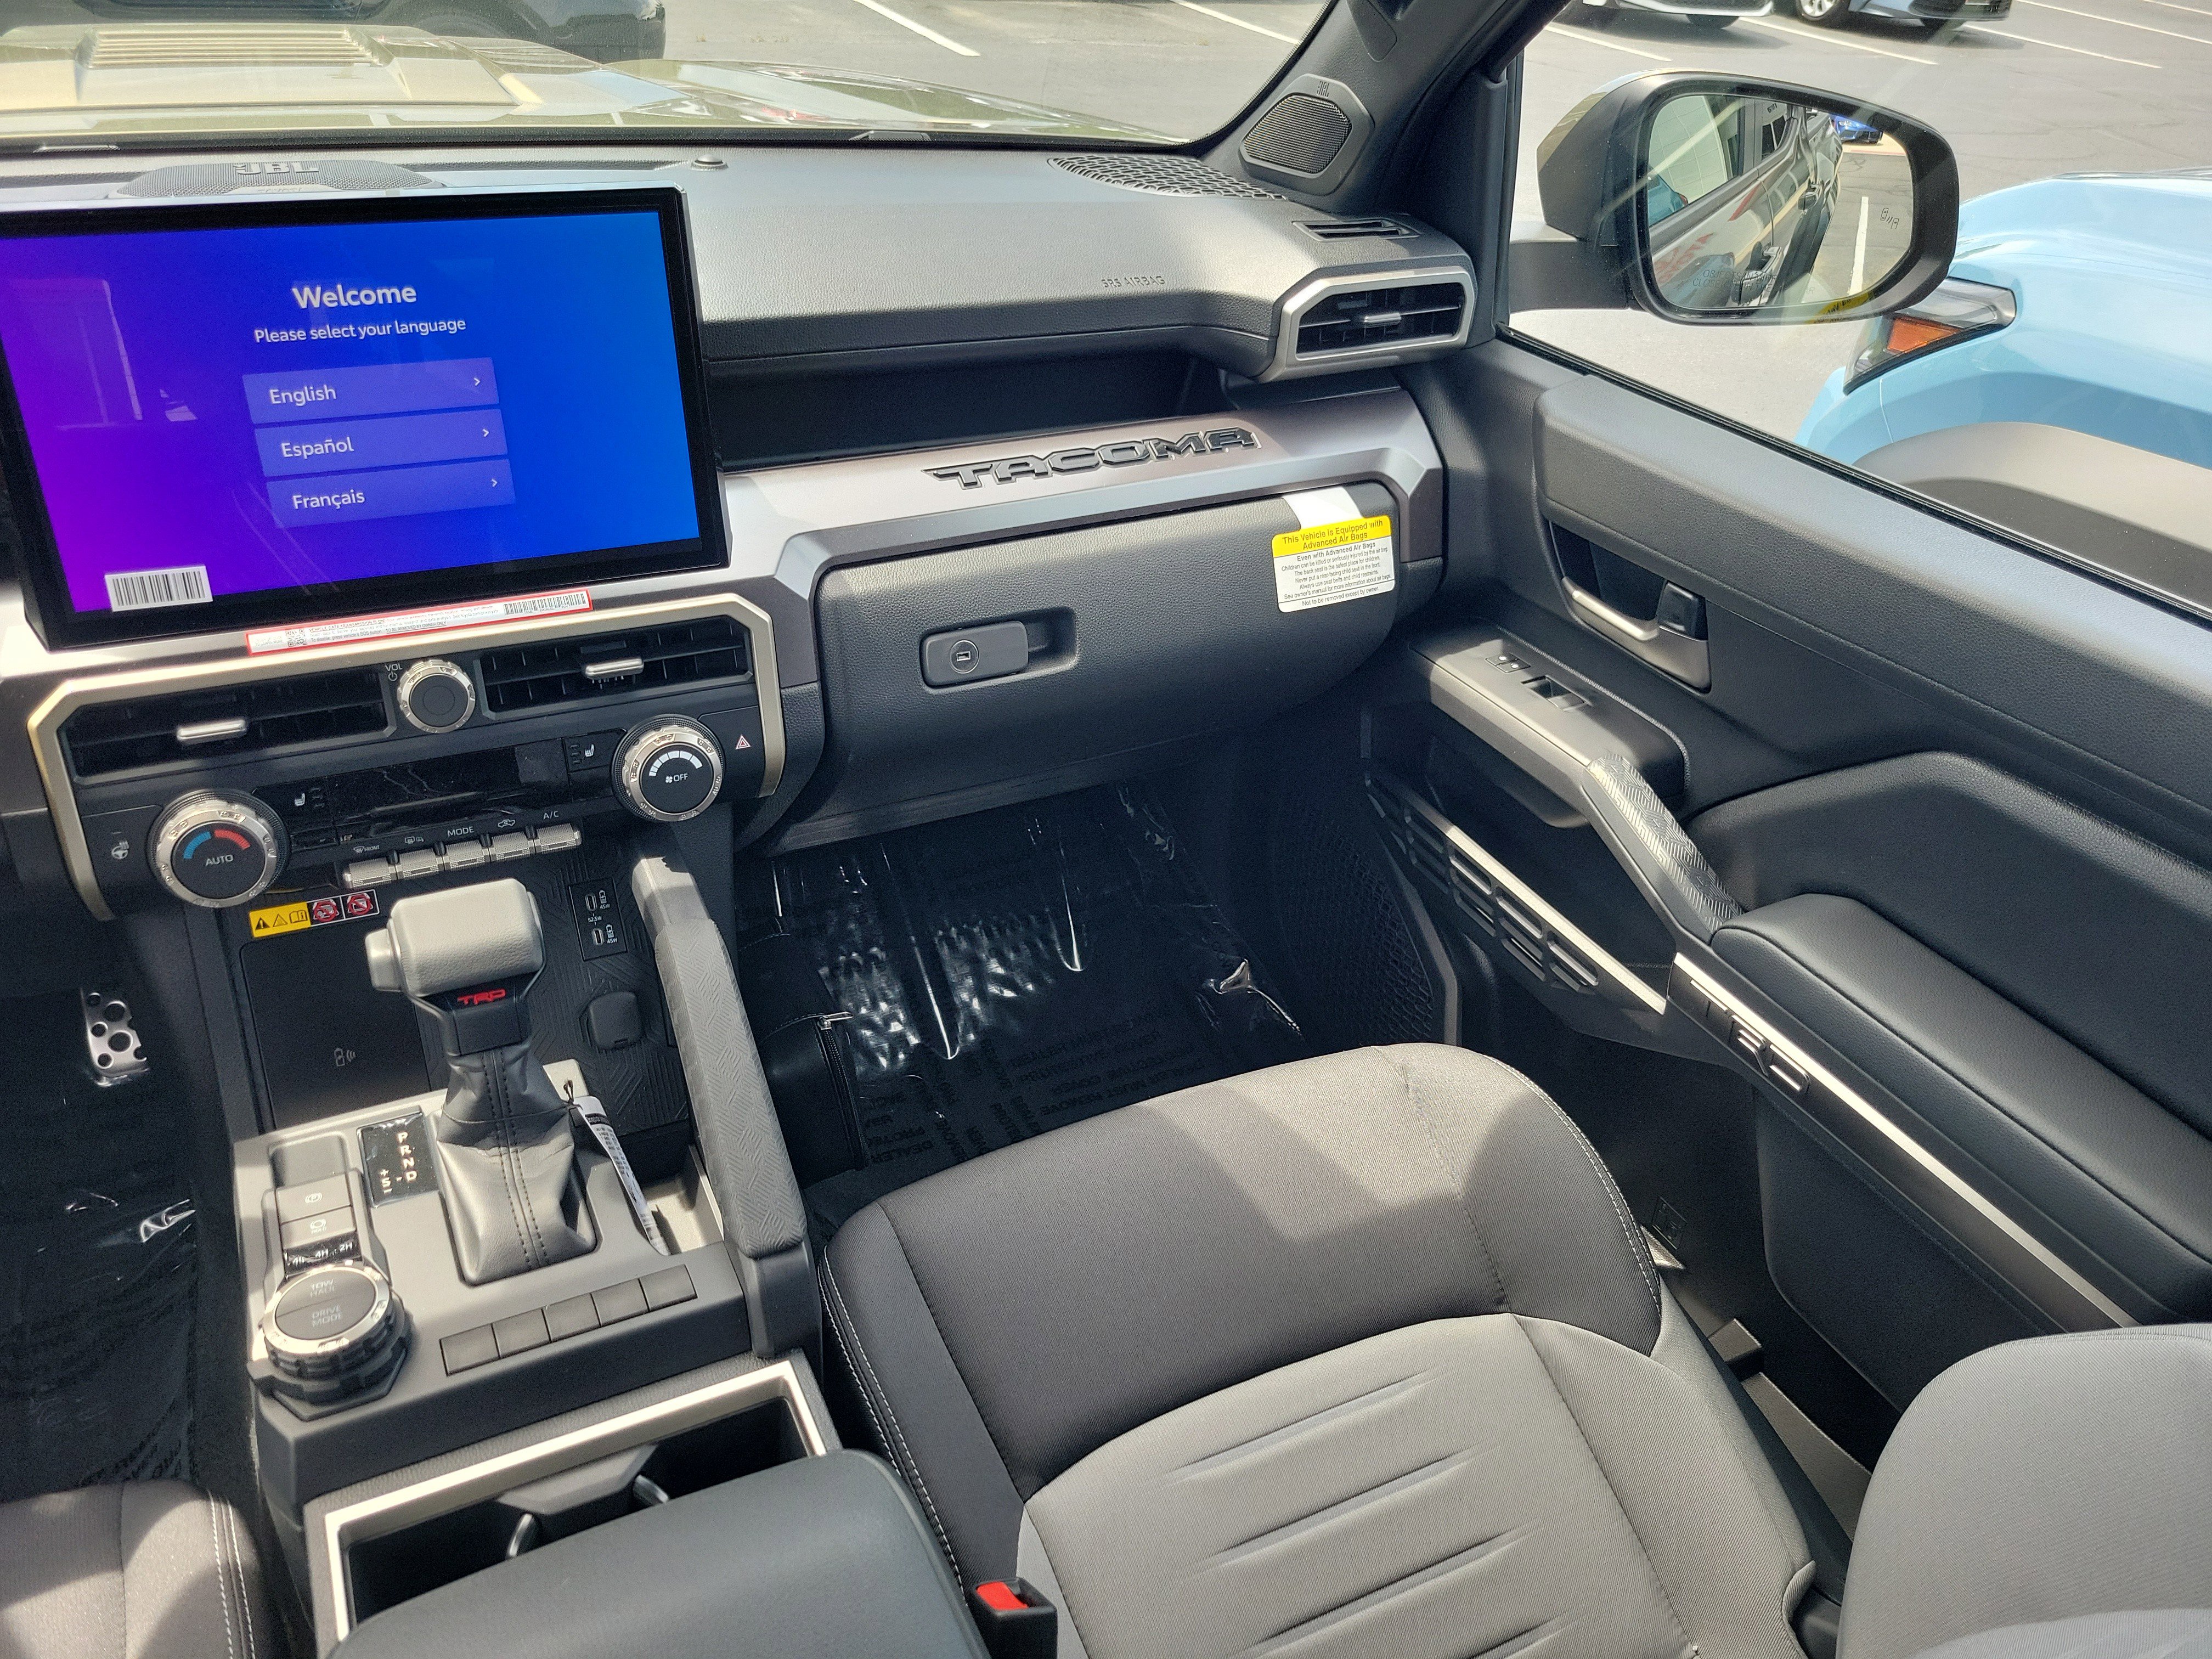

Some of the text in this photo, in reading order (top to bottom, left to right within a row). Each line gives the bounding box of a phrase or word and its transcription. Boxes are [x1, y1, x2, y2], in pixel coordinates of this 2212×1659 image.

[1101, 276, 1165, 287] SRS AIRBAG
[292, 284, 417, 309] Welcome
[255, 318, 466, 343] Please select your language
[269, 385, 337, 406] English
[281, 437, 354, 459] Español
[922, 427, 1262, 489] TACOMA
[292, 488, 365, 510] Français
[1282, 535, 1299, 545] This
[1300, 531, 1326, 541] Vehicle
[1335, 522, 1368, 535] Equipped
[1369, 520, 1383, 528] with
[1302, 532, 1368, 550] Advanced Air Bags
[1325, 545, 1352, 556] Advanced
[1345, 579, 1365, 588] information
[1325, 593, 1344, 602] removed
[674, 773, 688, 782] OFF
[543, 810, 559, 820] A/C
[448, 826, 474, 837] MODE
[205, 854, 234, 866] AUTO
[458, 989, 506, 1005] TRD
[1690, 979, 1809, 1094] TRD
[398, 1132, 408, 1143] P
[400, 1145, 412, 1156] R
[403, 1157, 415, 1169] N
[406, 1170, 417, 1182] D
[382, 1177, 391, 1188] S
[315, 1249, 329, 1259] 4H
[339, 1242, 353, 1252] 2H
[311, 1279, 334, 1289] TOW
[310, 1286, 335, 1297] HAUL
[311, 1305, 340, 1318] DRIVE
[312, 1312, 343, 1327] MODE
